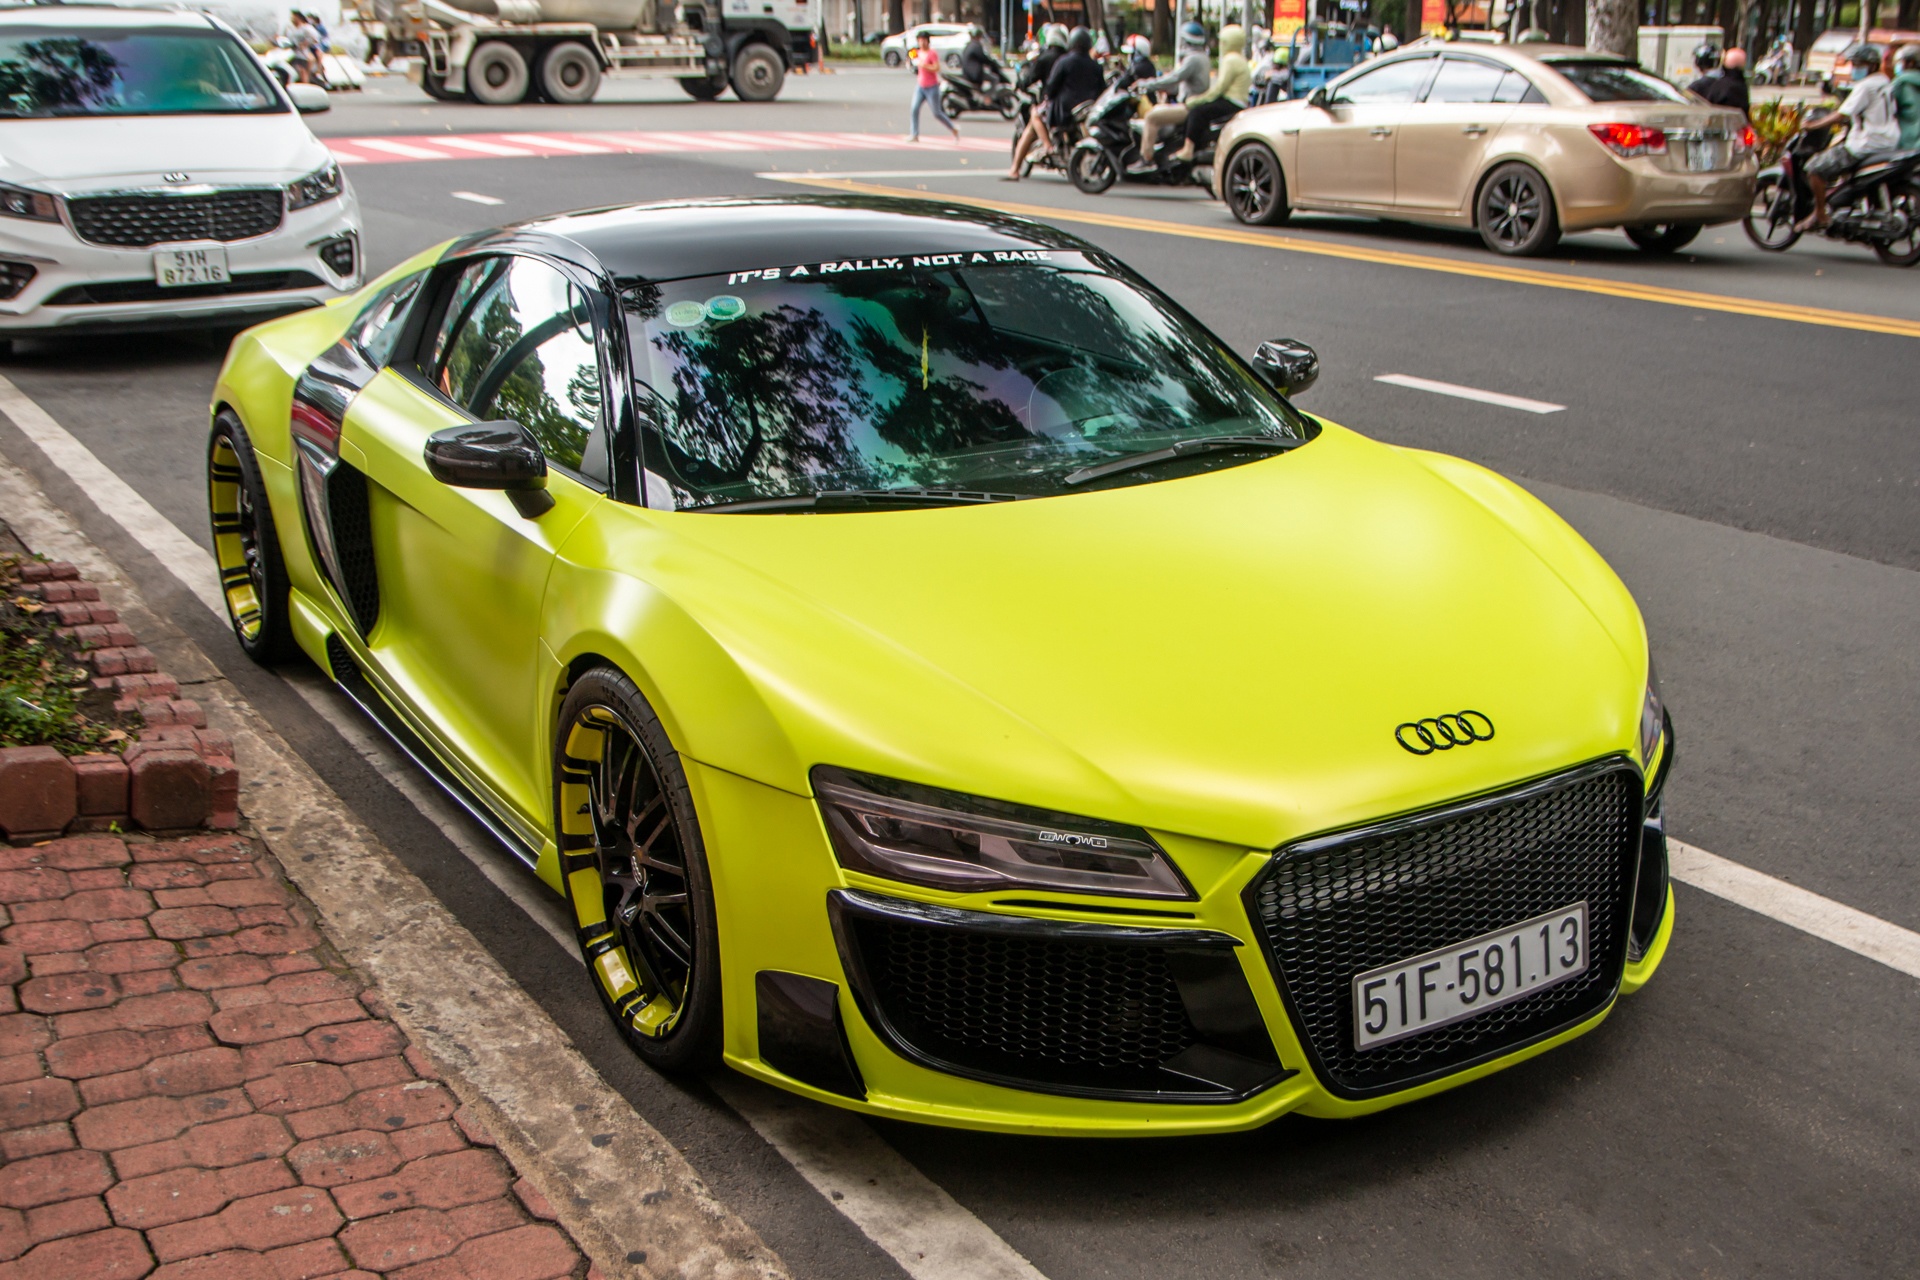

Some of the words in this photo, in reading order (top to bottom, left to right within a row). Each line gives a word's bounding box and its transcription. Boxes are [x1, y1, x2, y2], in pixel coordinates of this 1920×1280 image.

[174, 249, 207, 267] 51H
[728, 268, 781, 285] IT'S
[789, 265, 810, 277] A
[820, 257, 904, 274] RALLY,
[912, 253, 963, 267] NOT
[971, 252, 988, 263] A
[993, 251, 1052, 262] RACE
[1363, 916, 1579, 1034] 51F-581.13
